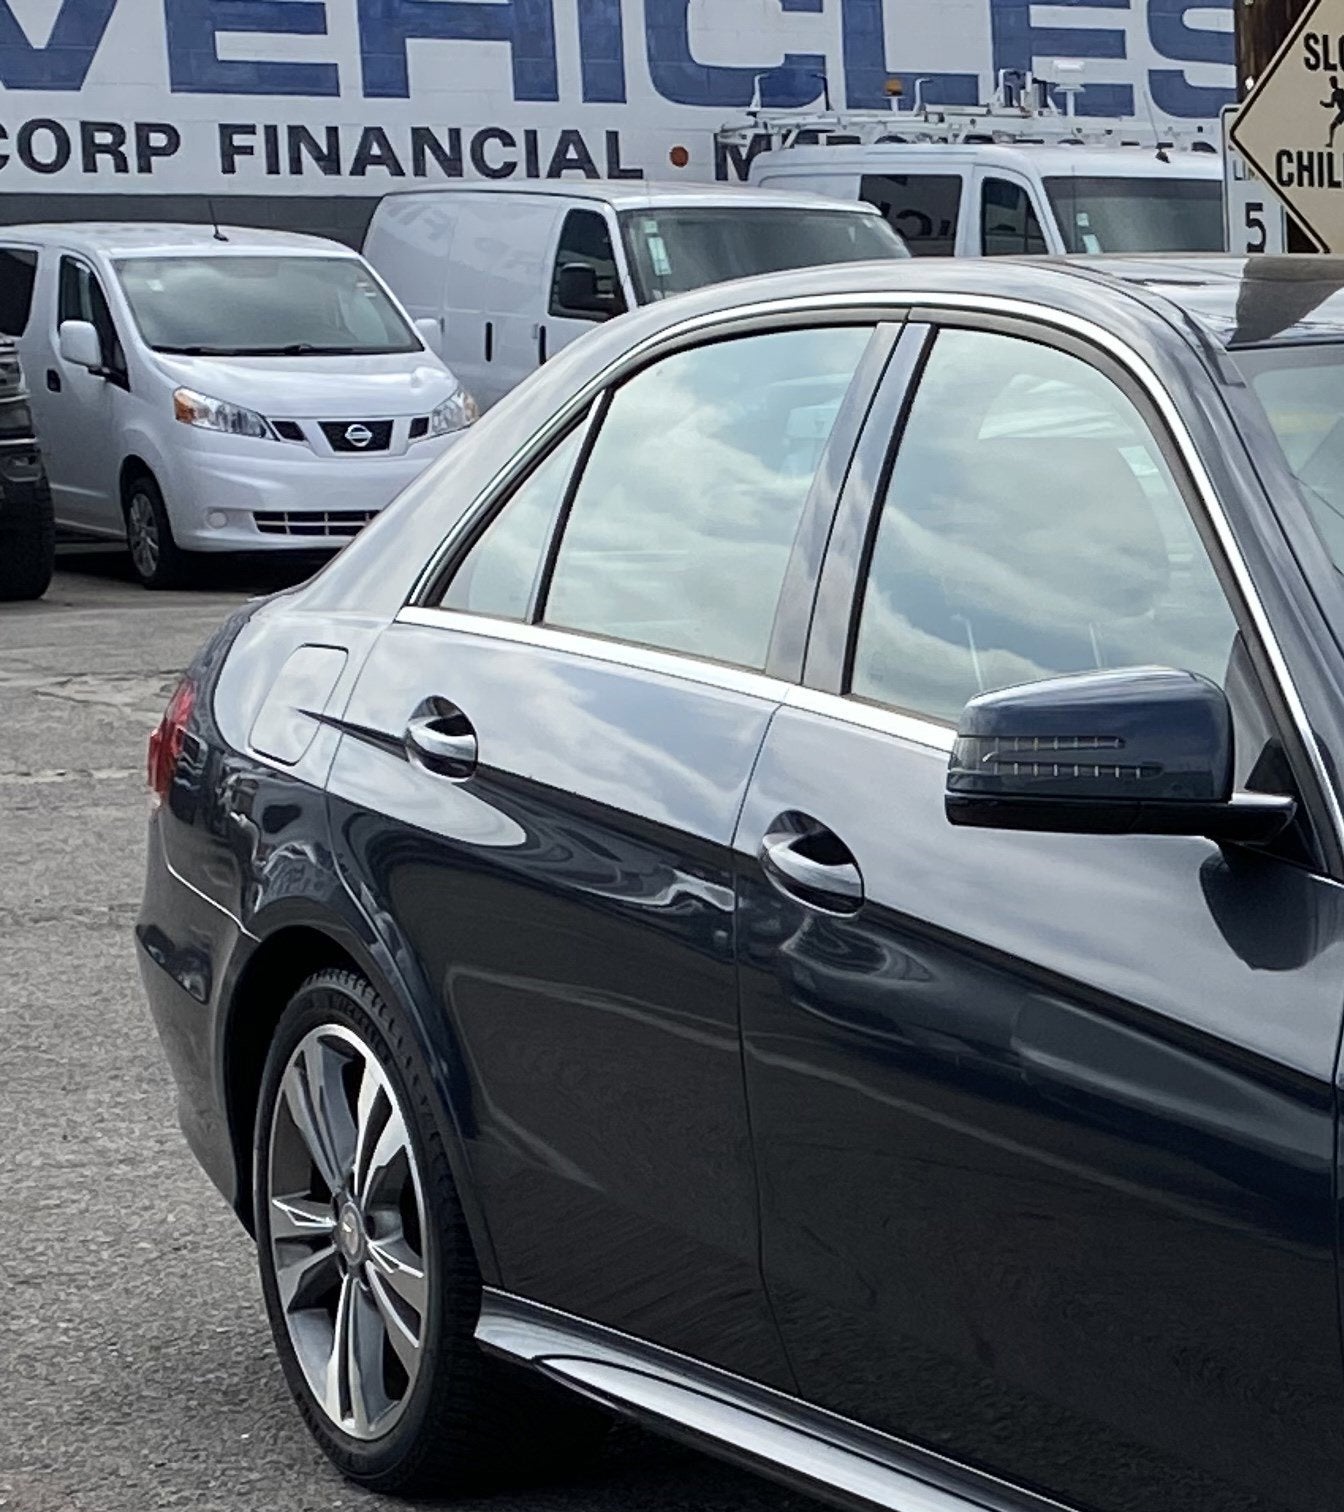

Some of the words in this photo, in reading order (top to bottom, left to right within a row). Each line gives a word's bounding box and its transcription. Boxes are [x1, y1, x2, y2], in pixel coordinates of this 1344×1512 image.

[0, 0, 1238, 119] VEHICLES
[0, 118, 181, 174] ORP
[218, 122, 644, 181] FINANCIAL
[1245, 202, 1267, 254] 5
